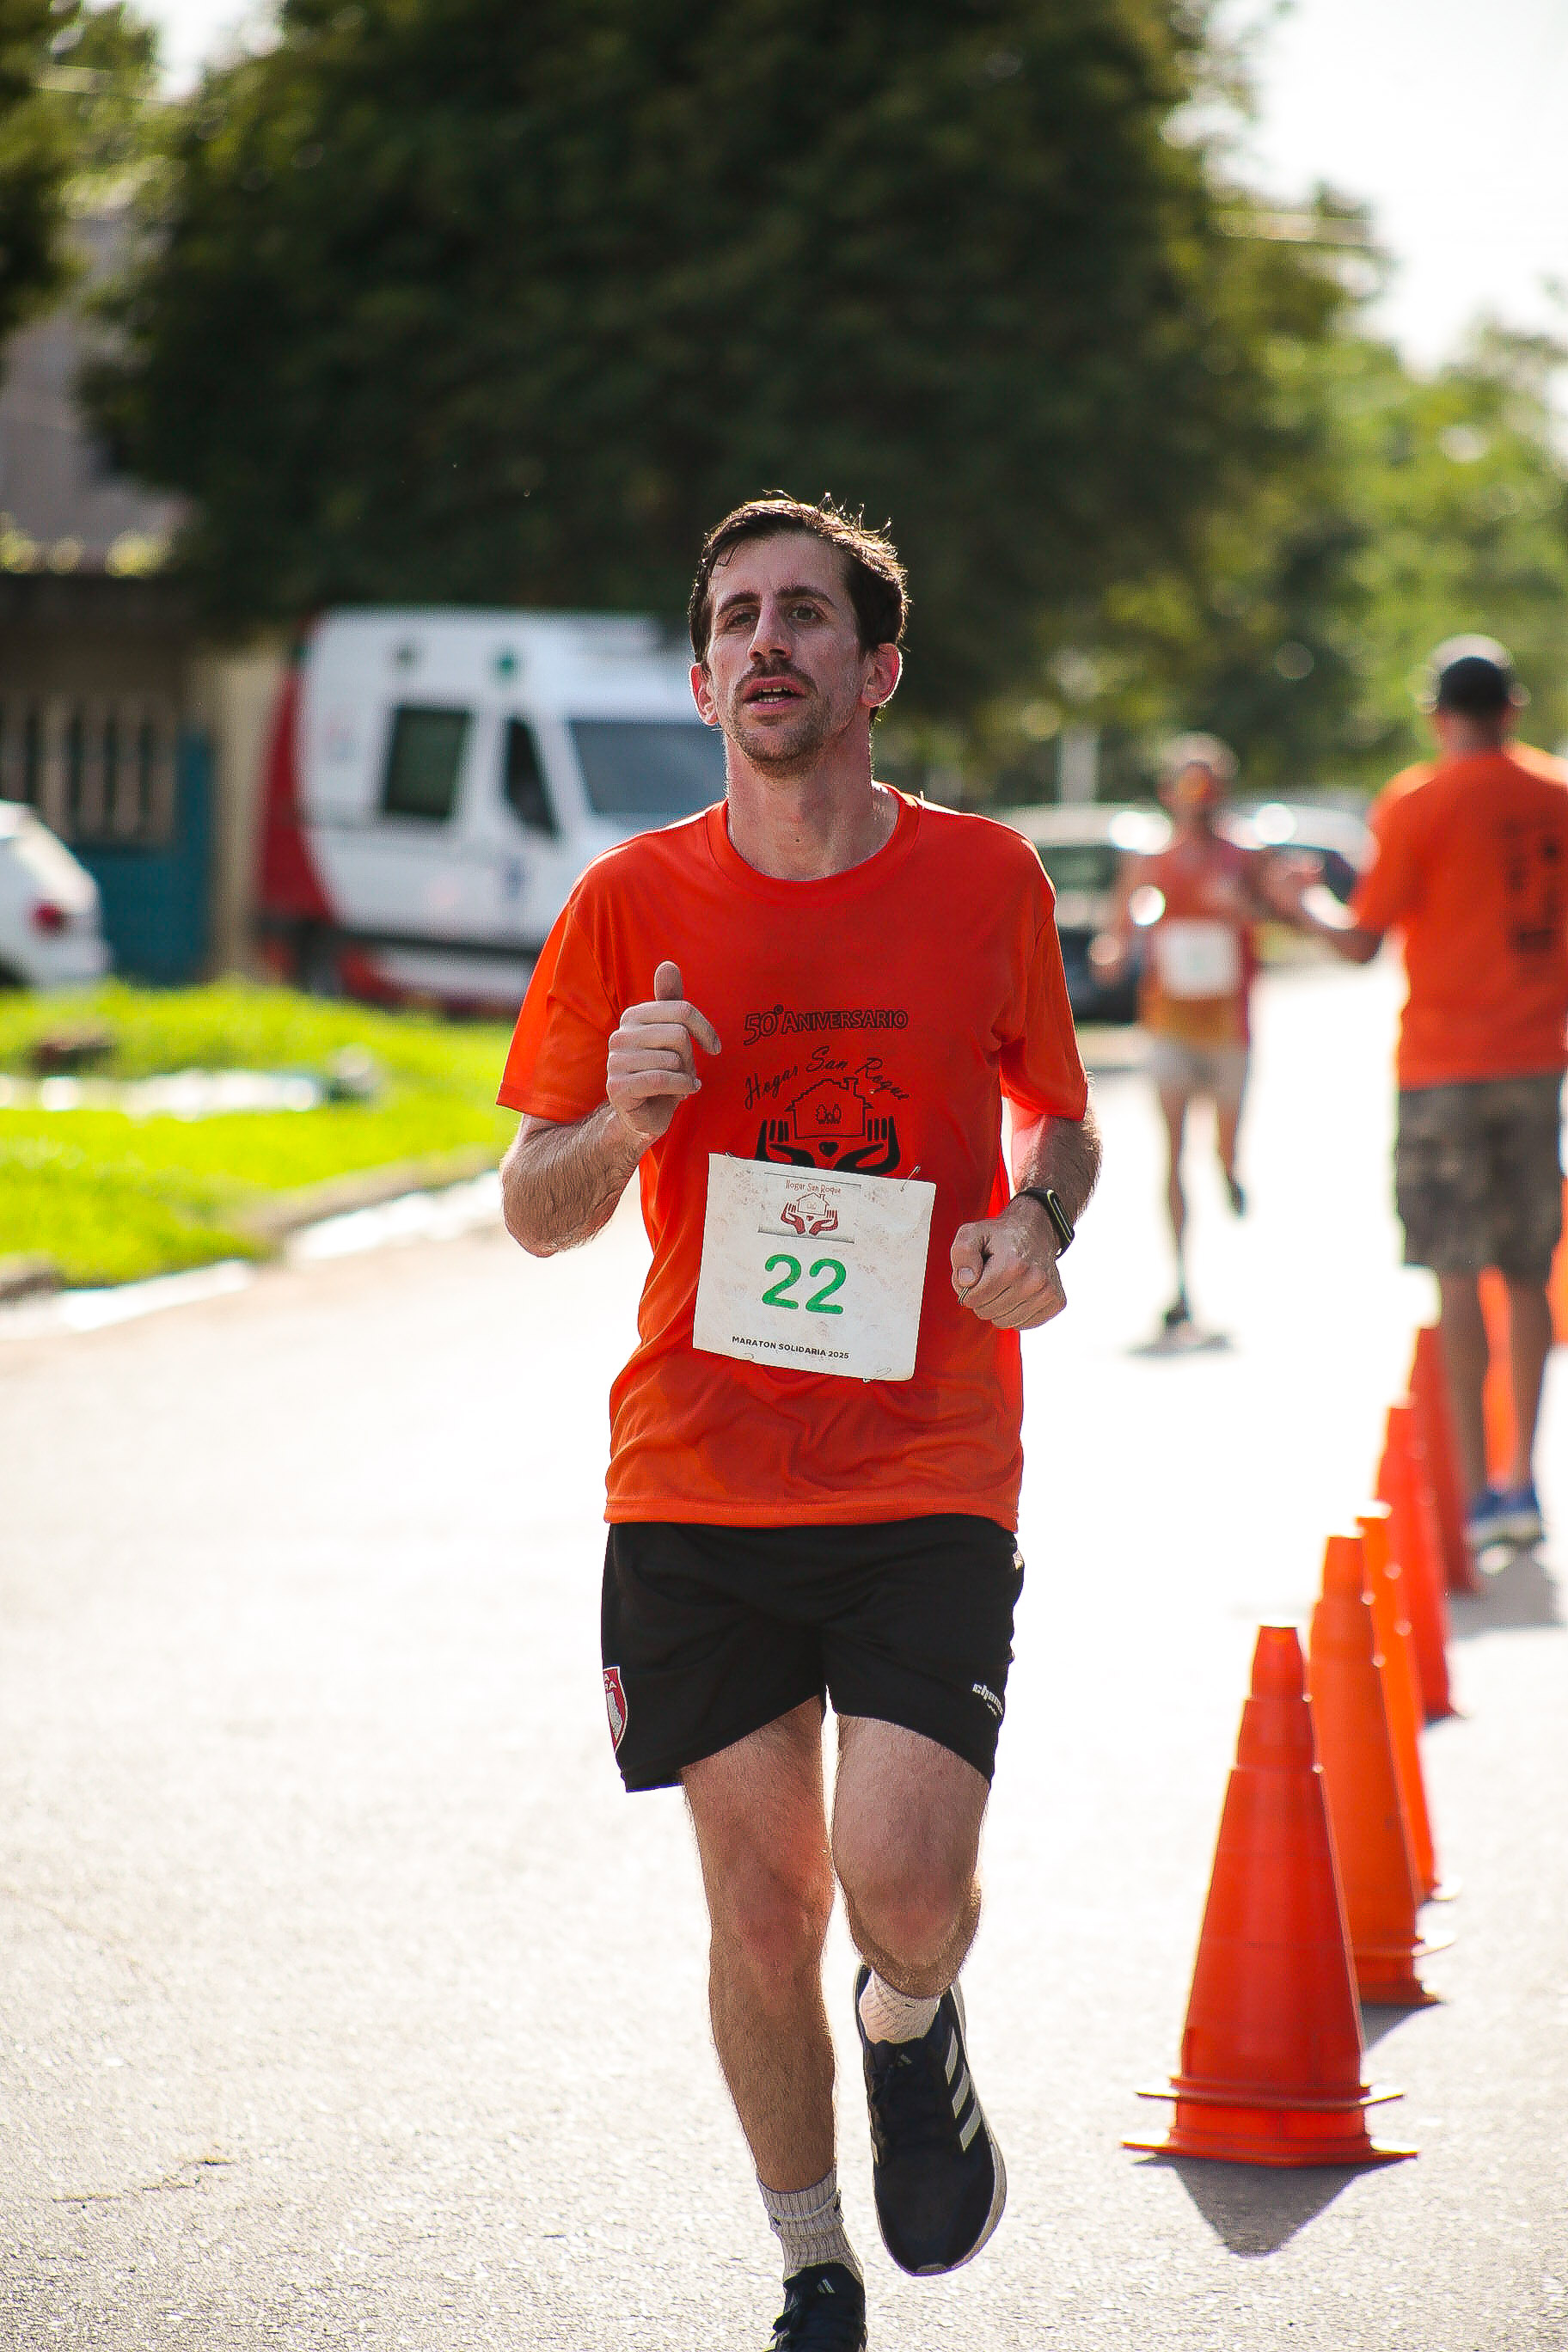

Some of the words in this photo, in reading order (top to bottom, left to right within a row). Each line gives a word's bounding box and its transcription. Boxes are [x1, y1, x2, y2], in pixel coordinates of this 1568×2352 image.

[744, 1065, 799, 1111] Hogar
[805, 1045, 848, 1073] San
[786, 1179, 805, 1191] Hogar
[806, 1182, 819, 1192] San
[820, 1184, 842, 1196] Roque
[762, 1254, 847, 1314] 22
[732, 1336, 776, 1350] MARATON
[778, 1343, 826, 1357] SOLIDARIA
[828, 1351, 849, 1360] 2025
